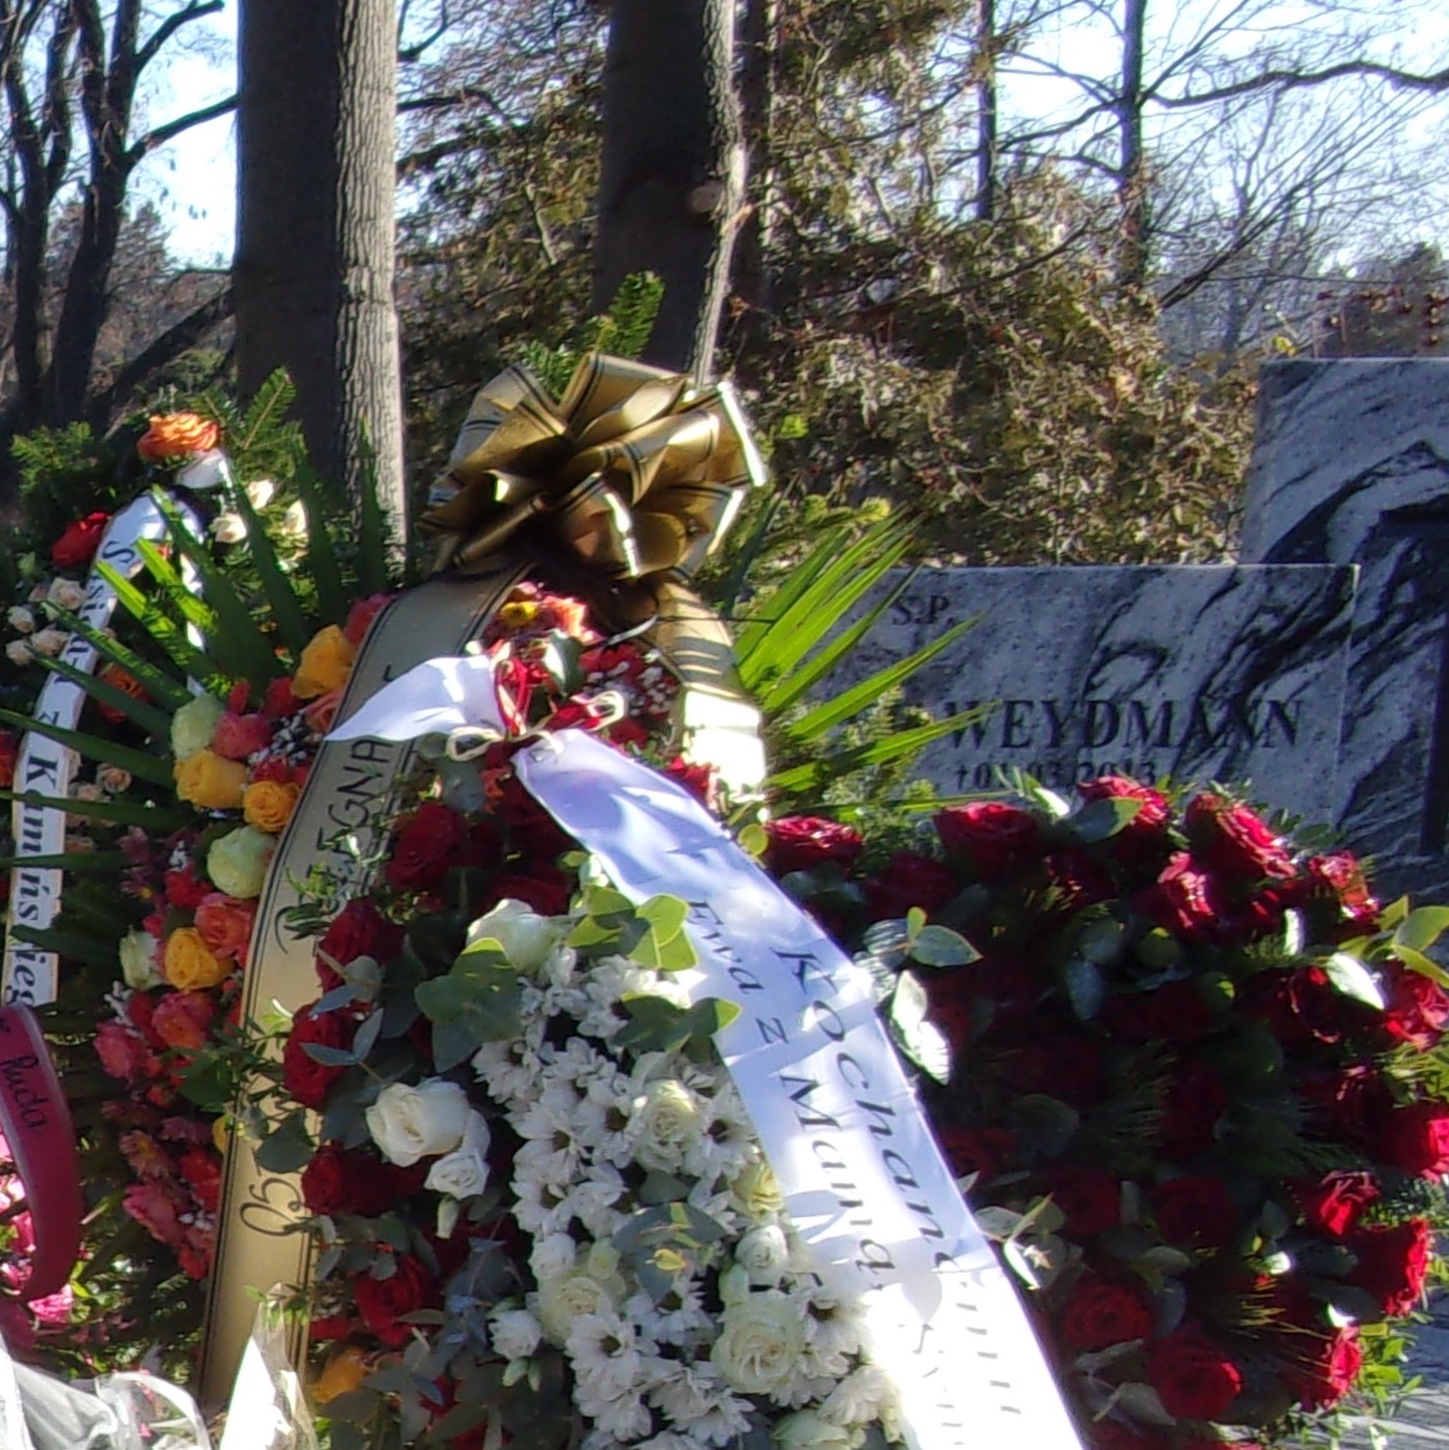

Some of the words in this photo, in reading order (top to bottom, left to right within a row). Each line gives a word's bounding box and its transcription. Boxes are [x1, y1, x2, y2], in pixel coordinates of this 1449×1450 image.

[943, 698, 1301, 750] WEYDMANN
[687, 900, 765, 995] Ewa
[755, 1016, 789, 1045] z
